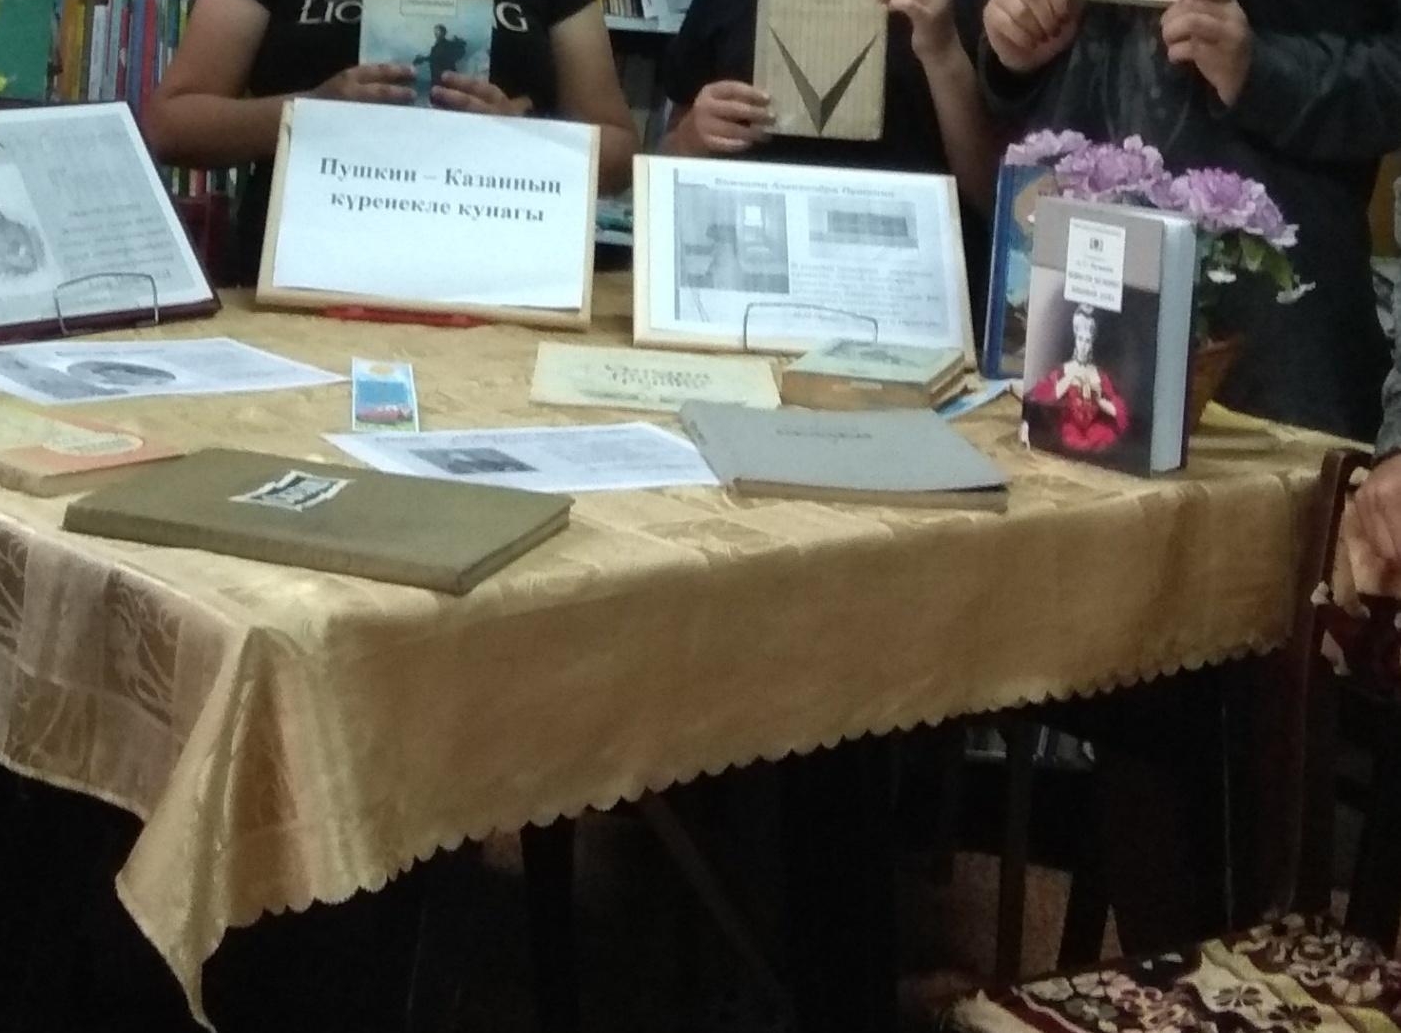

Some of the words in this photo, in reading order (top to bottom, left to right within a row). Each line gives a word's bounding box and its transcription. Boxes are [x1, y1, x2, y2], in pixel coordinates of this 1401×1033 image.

[318, 157, 417, 183] Пушкин
[444, 167, 562, 197] Казанның
[330, 193, 451, 214] күренекле
[458, 204, 545, 222] кунагы
